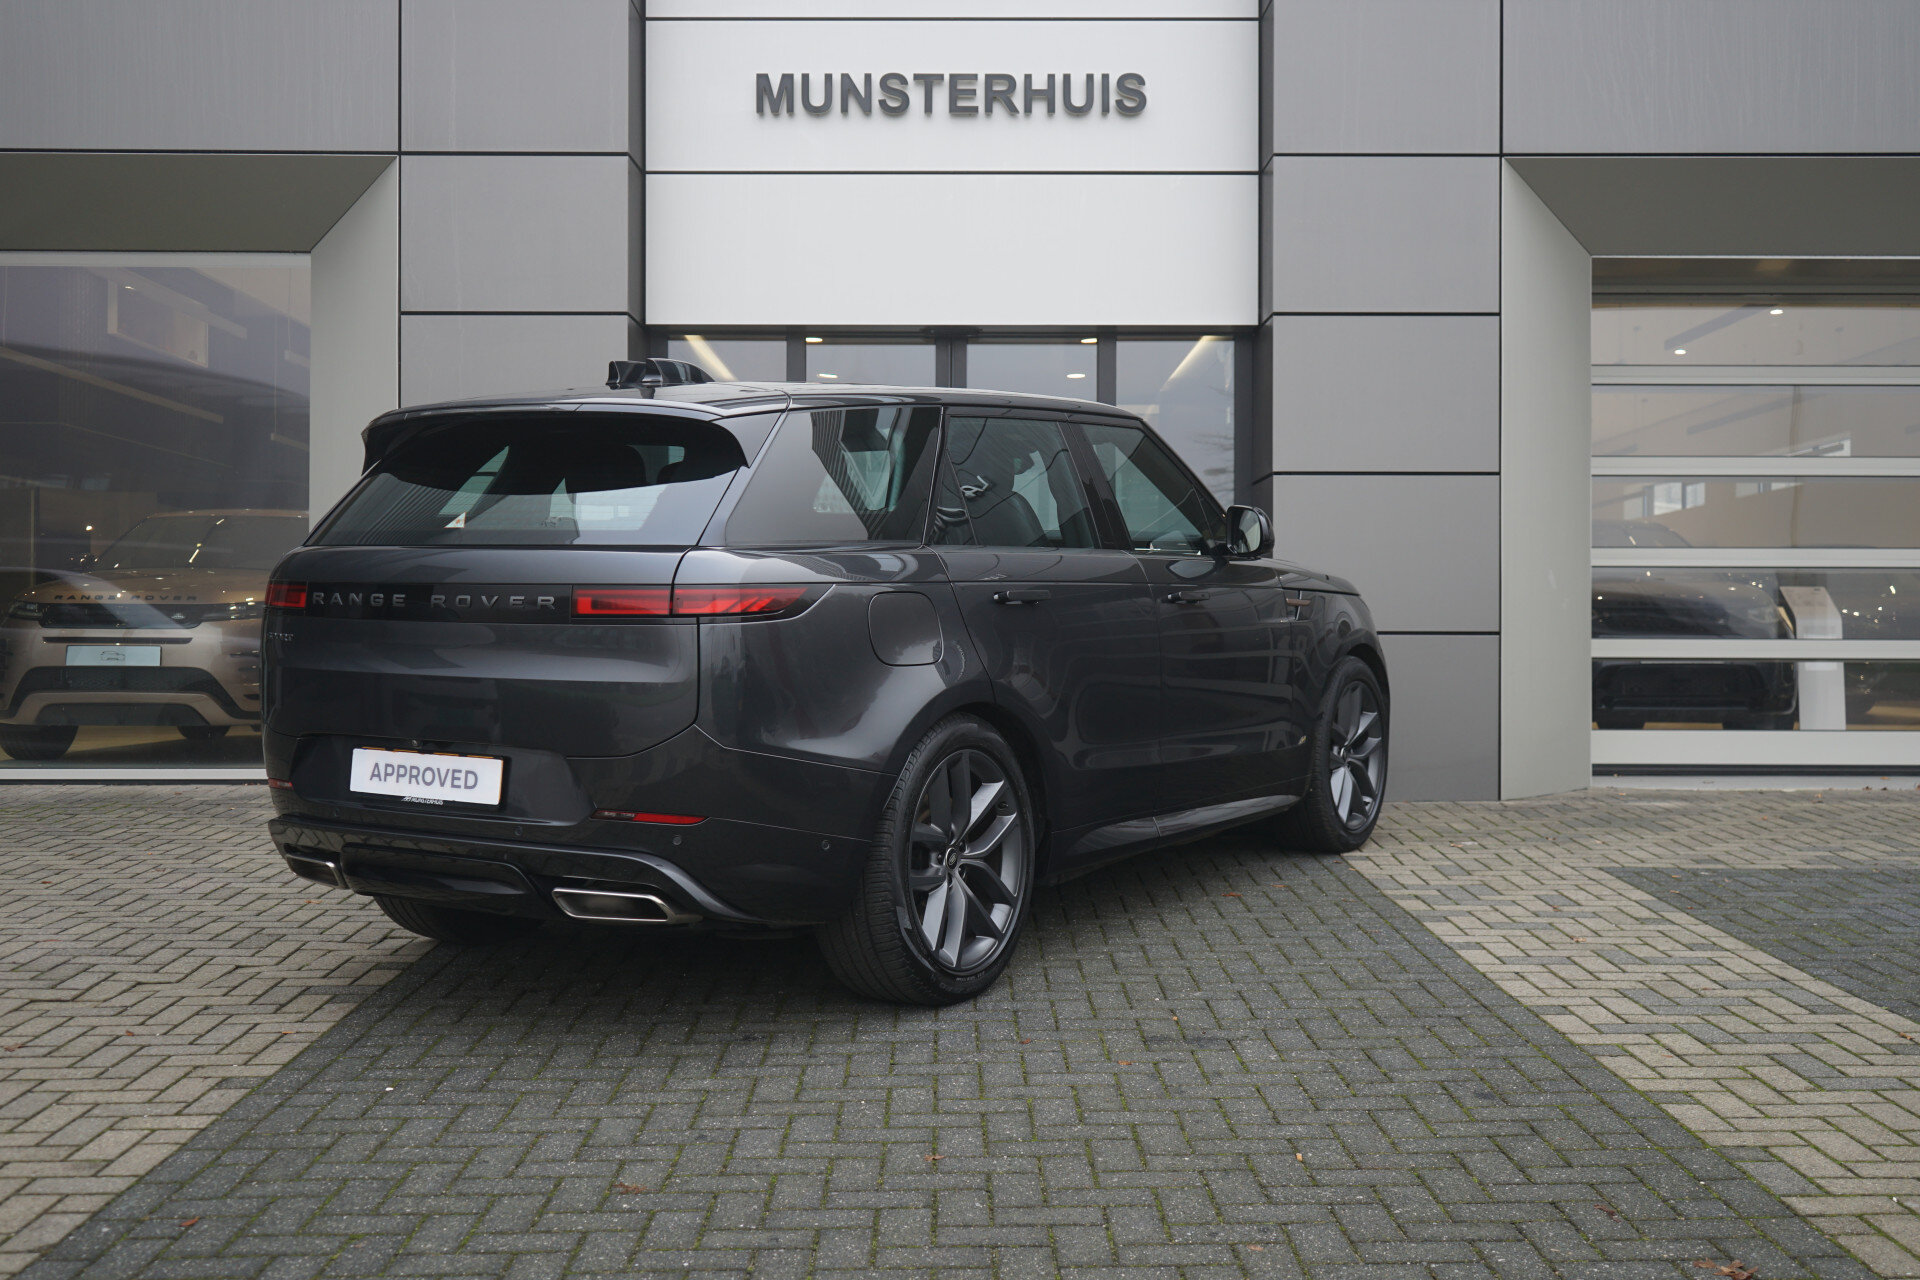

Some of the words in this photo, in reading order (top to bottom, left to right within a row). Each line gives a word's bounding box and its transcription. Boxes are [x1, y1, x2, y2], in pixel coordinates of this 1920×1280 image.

[755, 72, 1147, 116] MUNSTERHUIS
[312, 591, 406, 607] RANGE
[430, 594, 556, 610] ROVER
[369, 762, 479, 790] APPROVED
